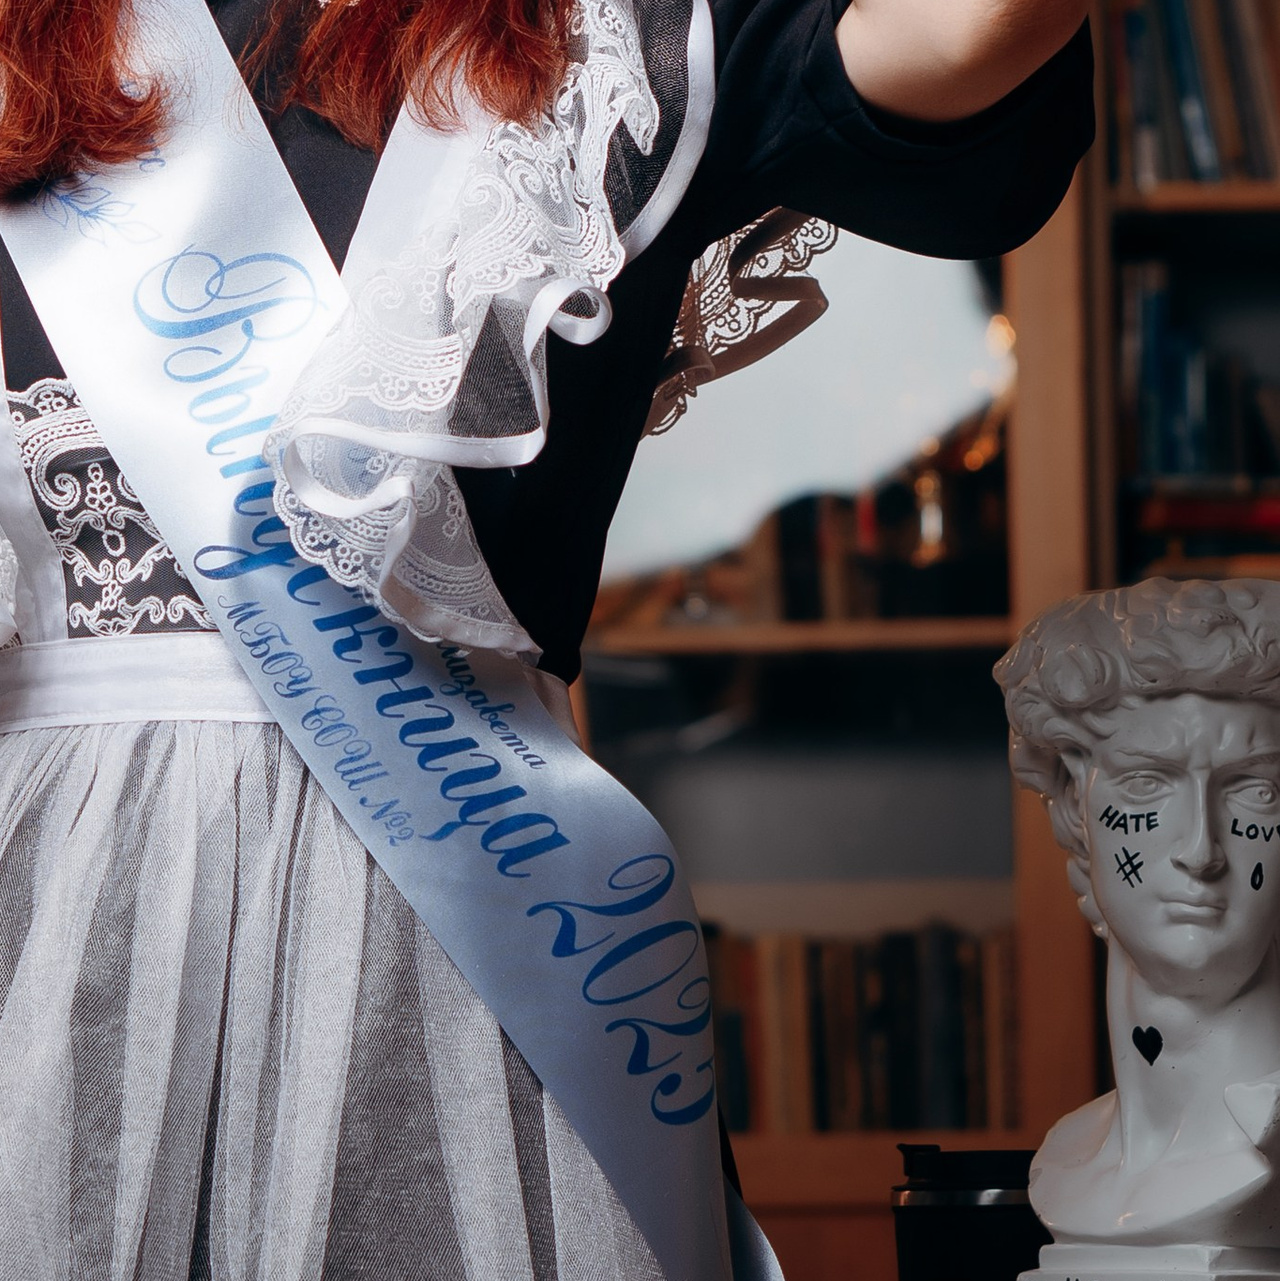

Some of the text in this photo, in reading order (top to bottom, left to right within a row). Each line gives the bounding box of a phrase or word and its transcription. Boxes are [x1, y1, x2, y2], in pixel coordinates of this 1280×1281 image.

[217, 594, 314, 700] МБОУ
[301, 693, 389, 793] СОШ
[436, 641, 547, 771] лизавета
[1098, 804, 1160, 836] HATE
